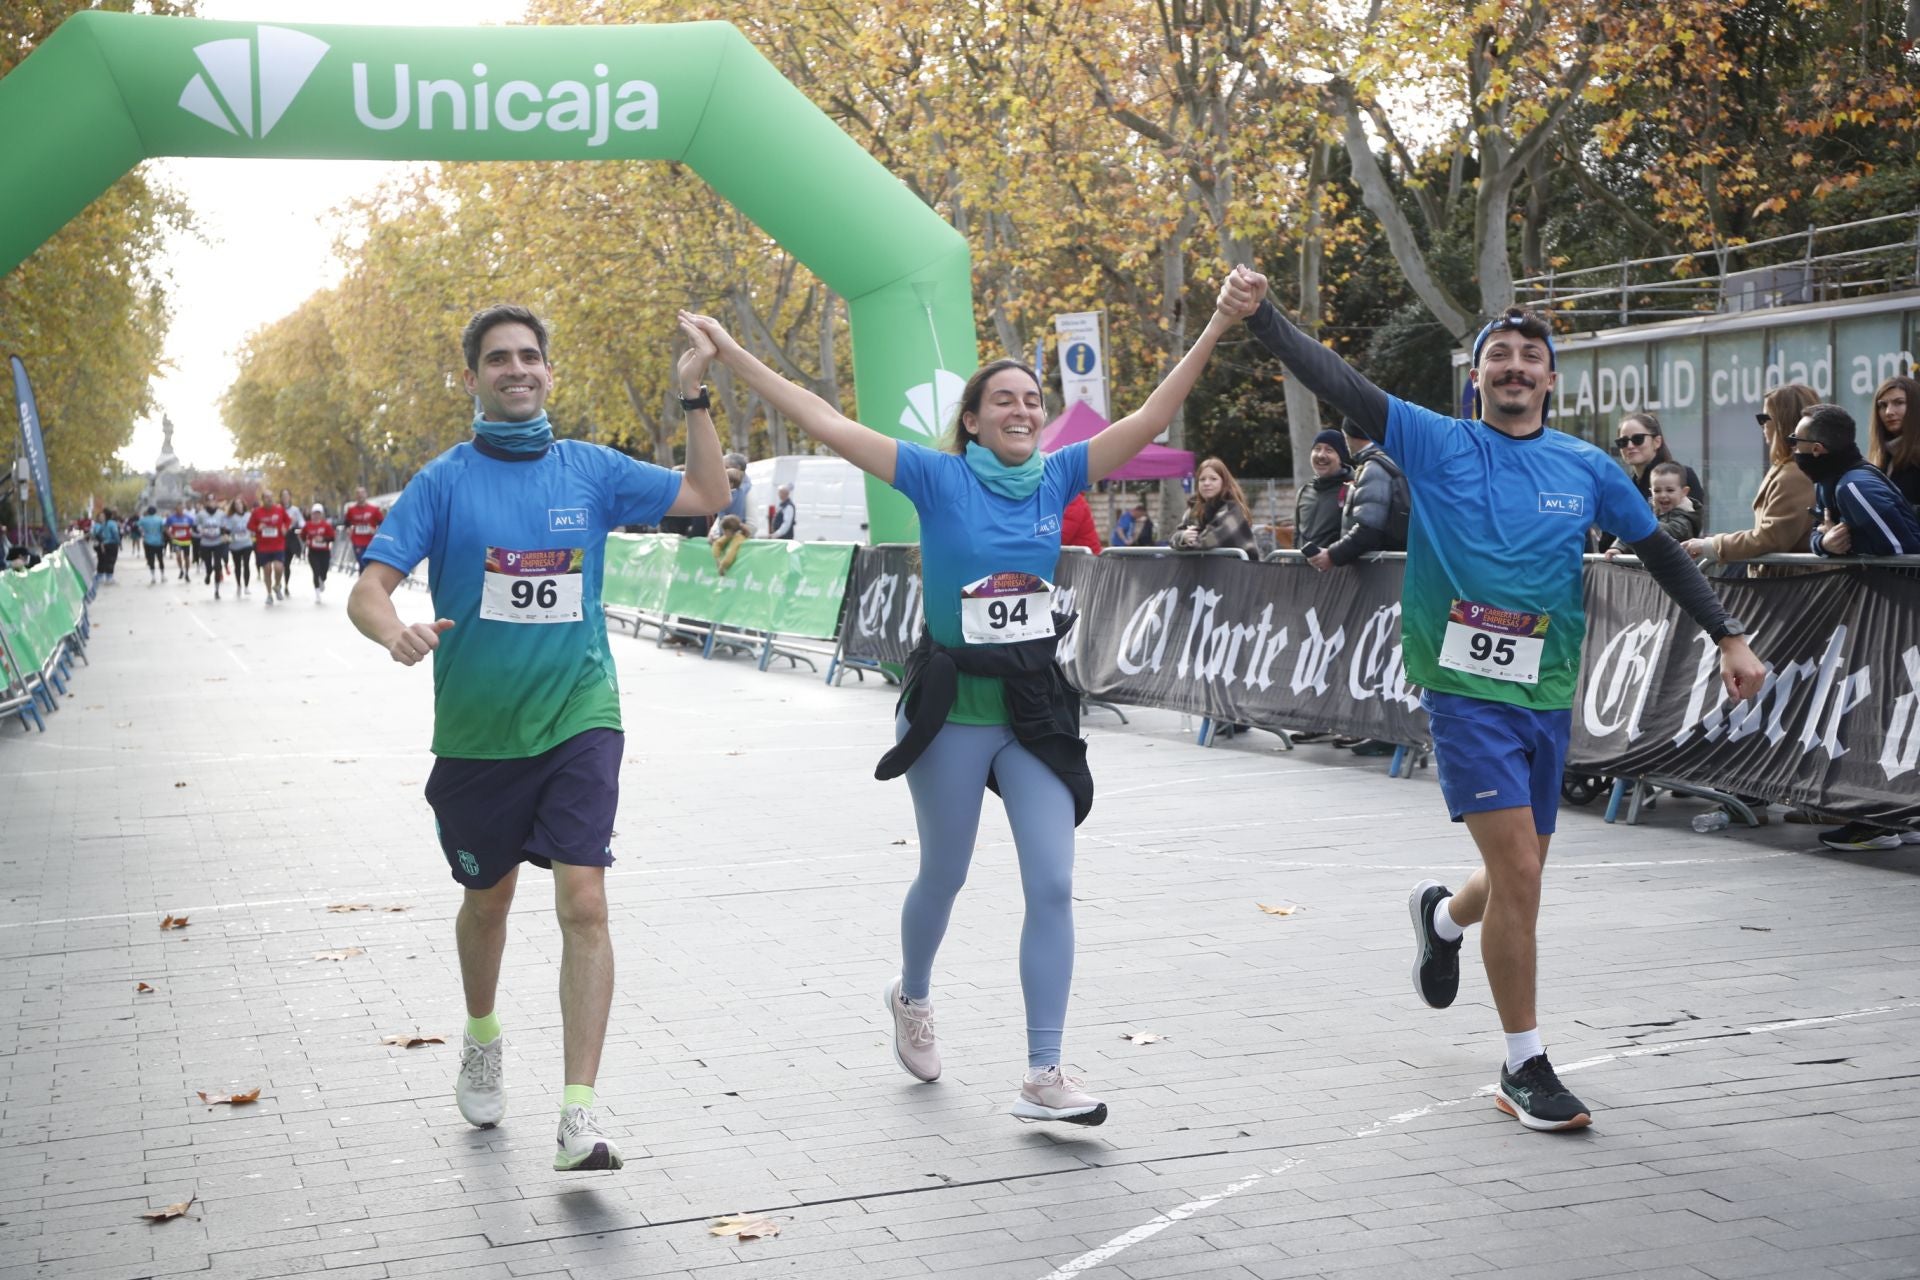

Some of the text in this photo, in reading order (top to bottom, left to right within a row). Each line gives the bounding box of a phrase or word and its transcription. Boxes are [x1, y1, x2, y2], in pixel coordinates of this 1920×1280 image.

[352, 61, 659, 147] Unicaja
[1547, 359, 1696, 418] LADOLID
[1711, 344, 1832, 405] ciudad
[1544, 499, 1565, 509] AVL
[555, 516, 575, 526] AVL
[520, 559, 555, 567] EMPRESAS
[521, 552, 548, 560] CARRERA
[993, 580, 1025, 588] EMPRESAS
[511, 579, 557, 609] 96
[988, 598, 1028, 629] 94
[1484, 608, 1512, 619] CARRERA
[1483, 614, 1519, 628] EMPRESAS
[1116, 586, 1178, 675] El
[1177, 585, 1288, 692] Norte
[1290, 607, 1345, 697] de
[1469, 632, 1517, 666] 95
